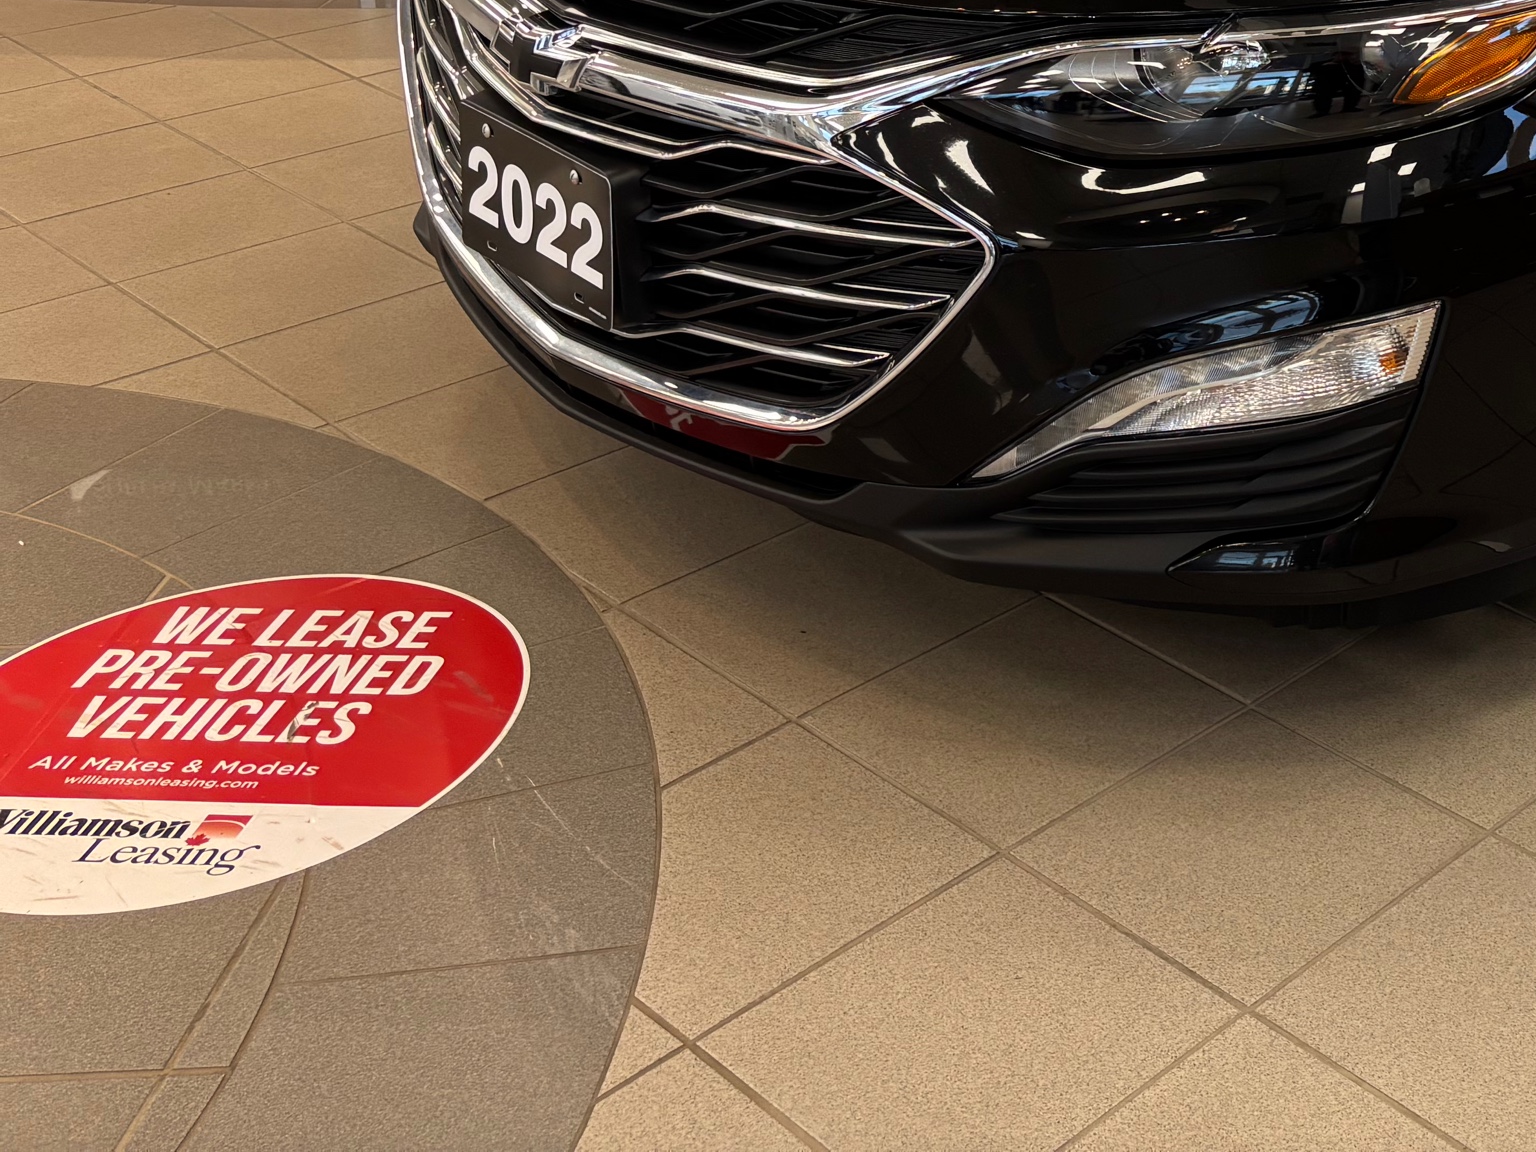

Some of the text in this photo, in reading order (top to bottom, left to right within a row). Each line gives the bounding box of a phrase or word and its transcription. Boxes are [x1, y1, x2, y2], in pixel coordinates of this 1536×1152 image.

[468, 146, 604, 290] 2022
[152, 606, 453, 649] WE LEASE
[70, 649, 445, 696] PRE-OWNED
[66, 695, 374, 745] VEHICLES
[28, 755, 320, 777] All Makes & Models
[63, 774, 259, 792] williamsonleasing.com
[74, 837, 261, 876] Leasing
